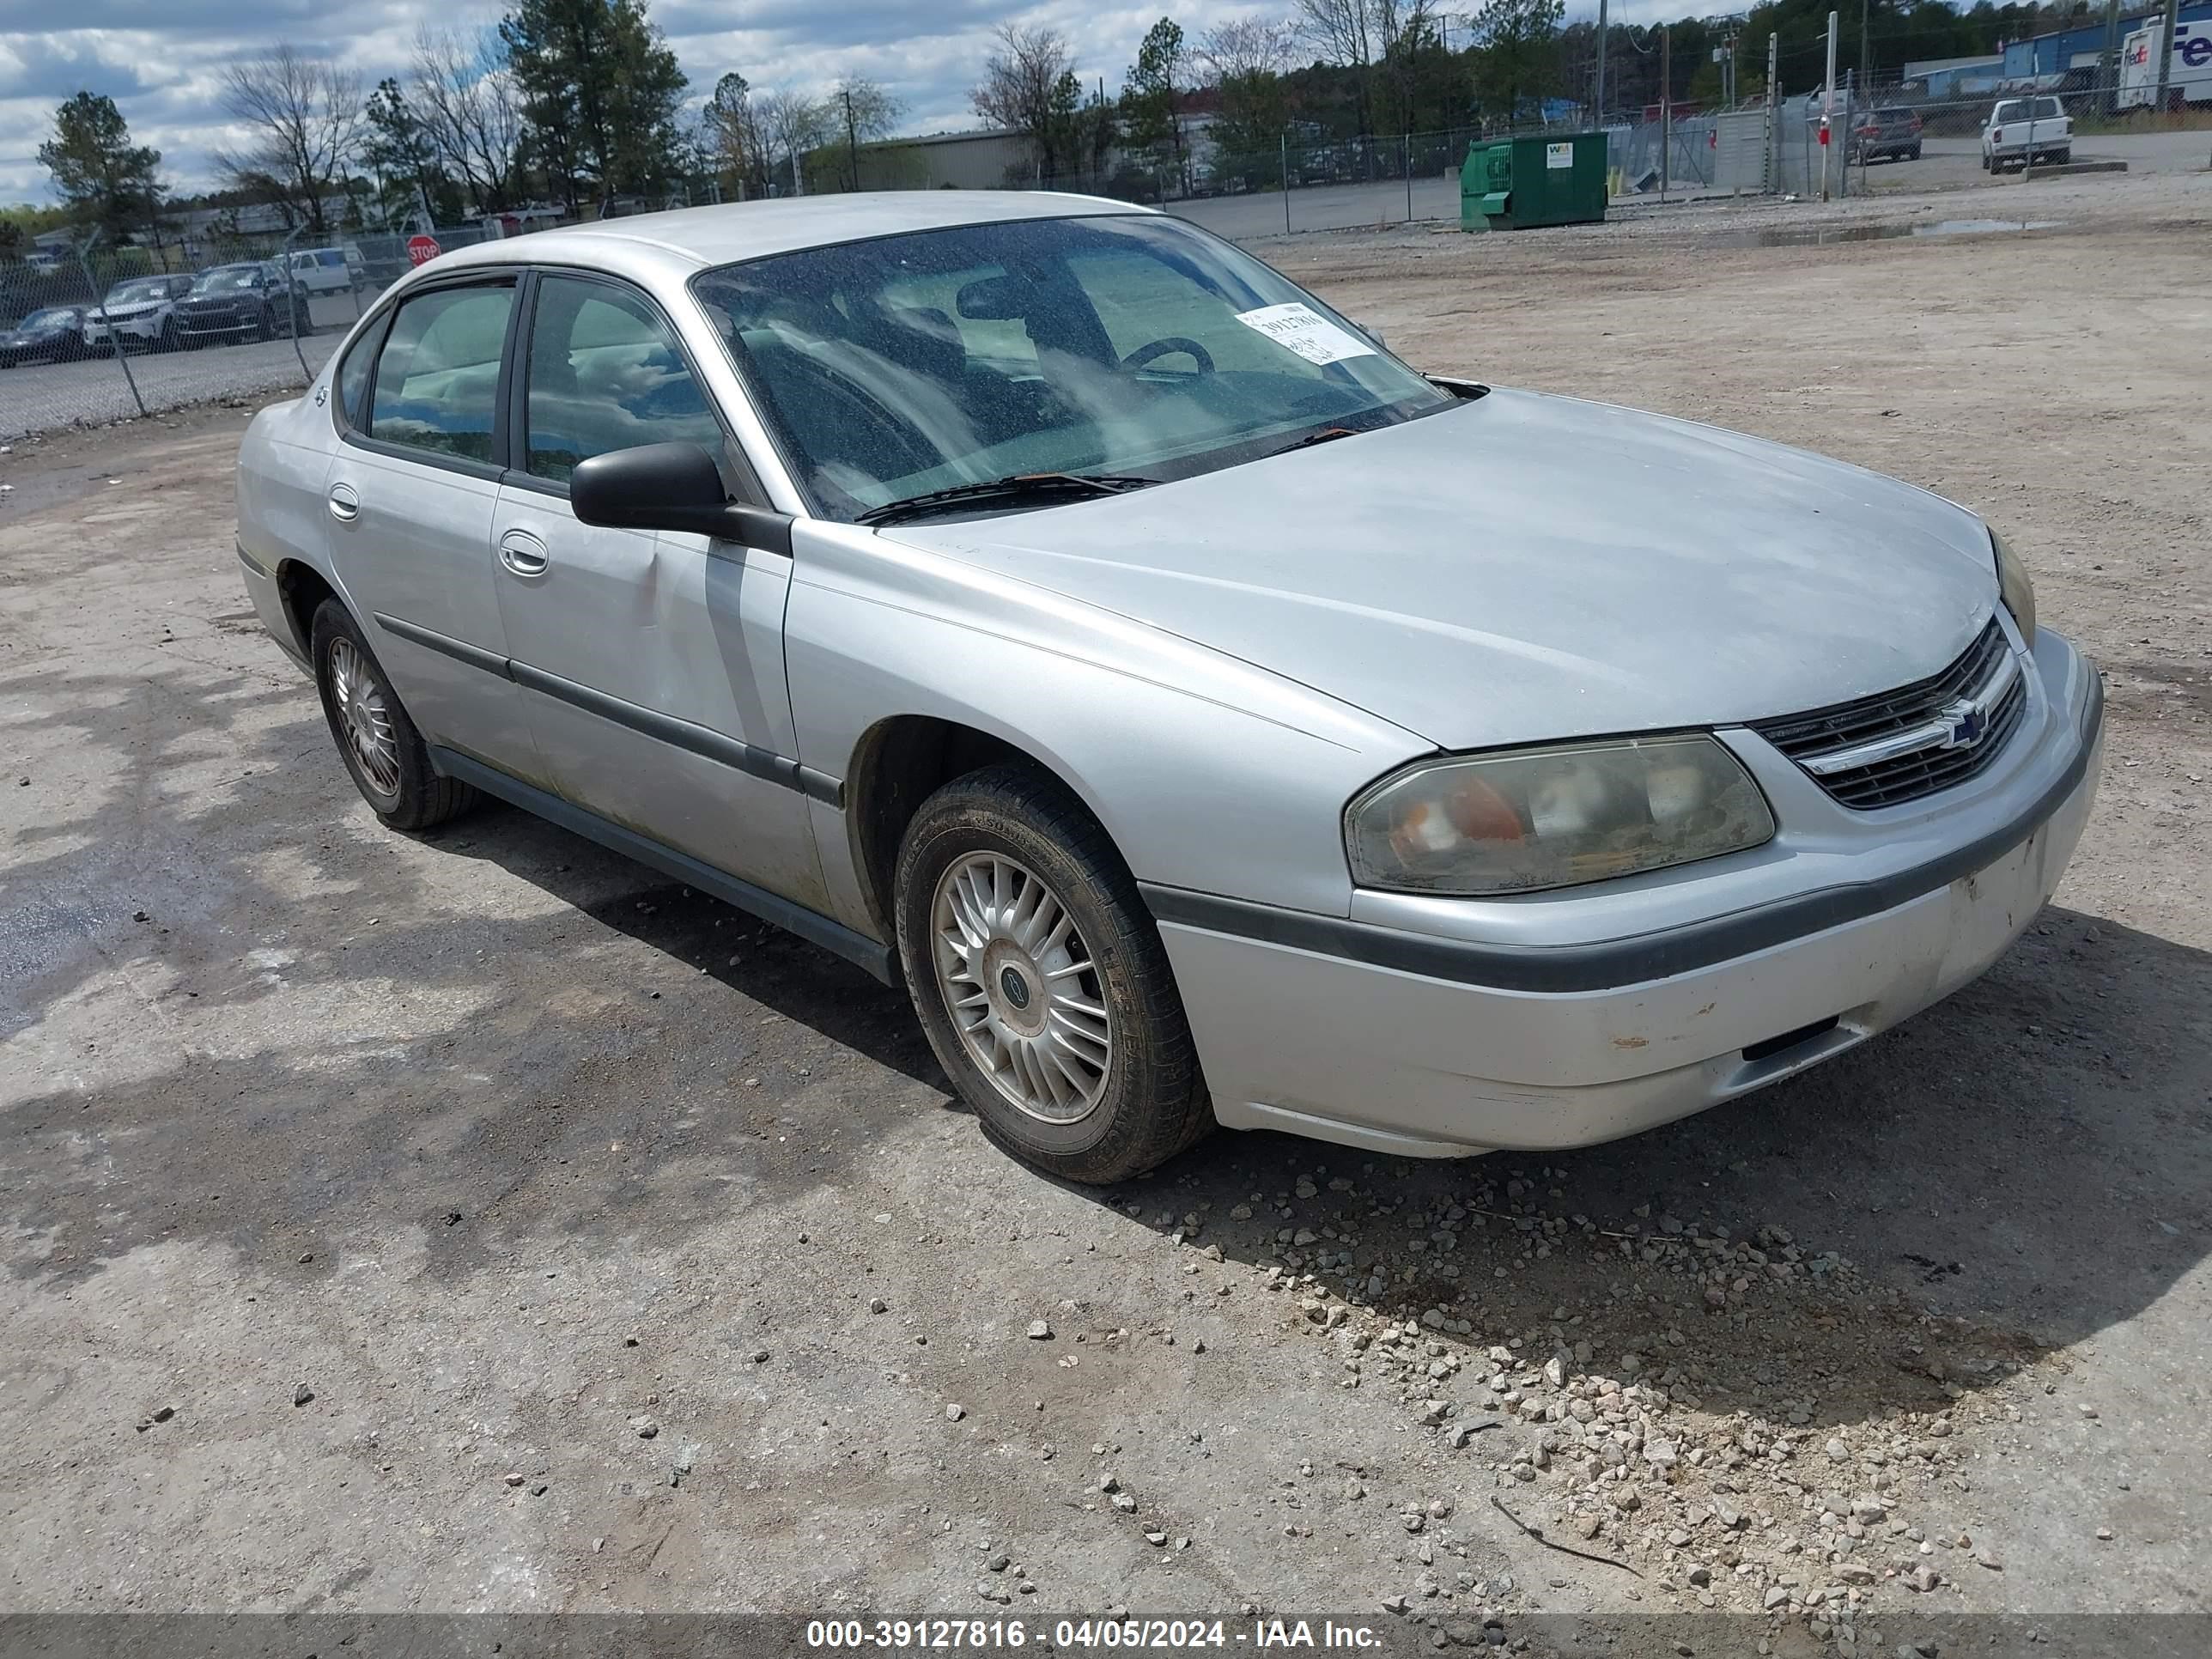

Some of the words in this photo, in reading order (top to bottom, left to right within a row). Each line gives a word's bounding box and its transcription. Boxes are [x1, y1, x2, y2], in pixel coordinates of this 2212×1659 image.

[1549, 144, 1569, 153] WM
[409, 244, 437, 260] STOP
[1261, 314, 1322, 334] 39127816
